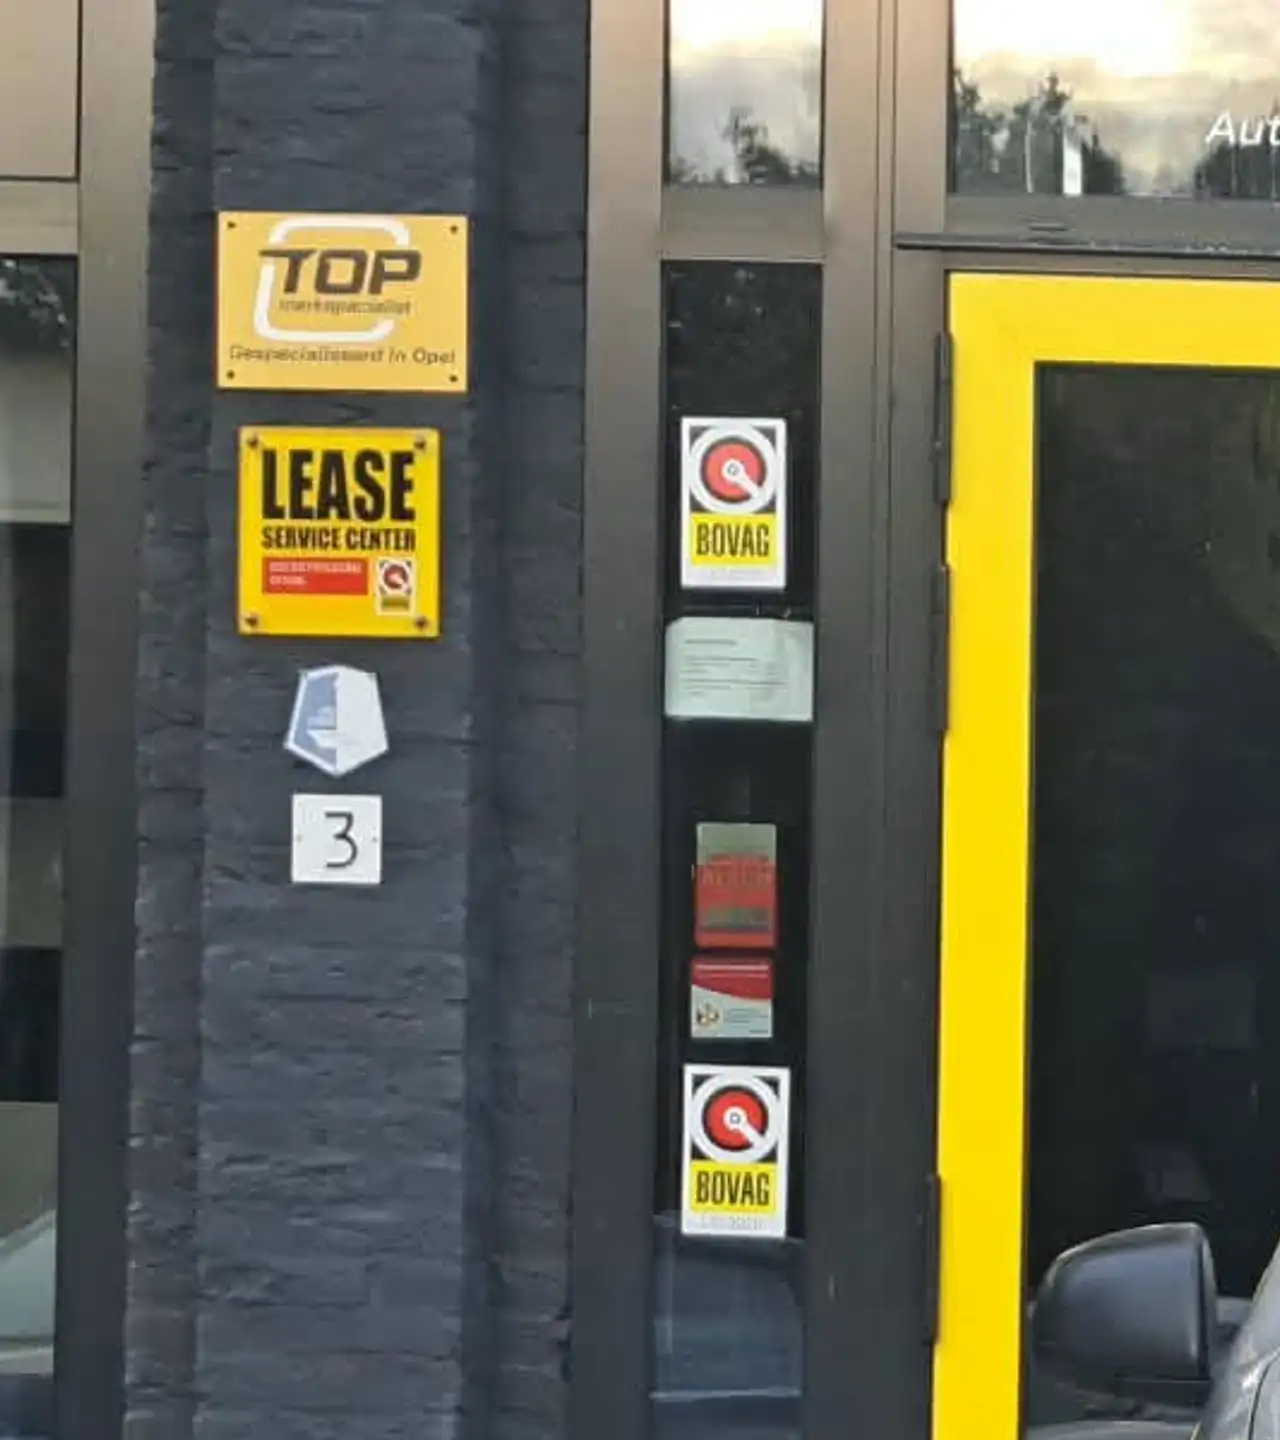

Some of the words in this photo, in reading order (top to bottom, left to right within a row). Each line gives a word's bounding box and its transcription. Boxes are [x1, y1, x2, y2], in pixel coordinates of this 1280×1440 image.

[257, 248, 422, 296] TOP
[411, 346, 457, 366] Opel
[261, 448, 417, 522] LEASE
[261, 525, 342, 551] SERVICE
[345, 527, 417, 554] CENTER
[696, 522, 770, 558] BOVAG
[324, 811, 358, 869] 3
[696, 1169, 770, 1207] BOVAG
